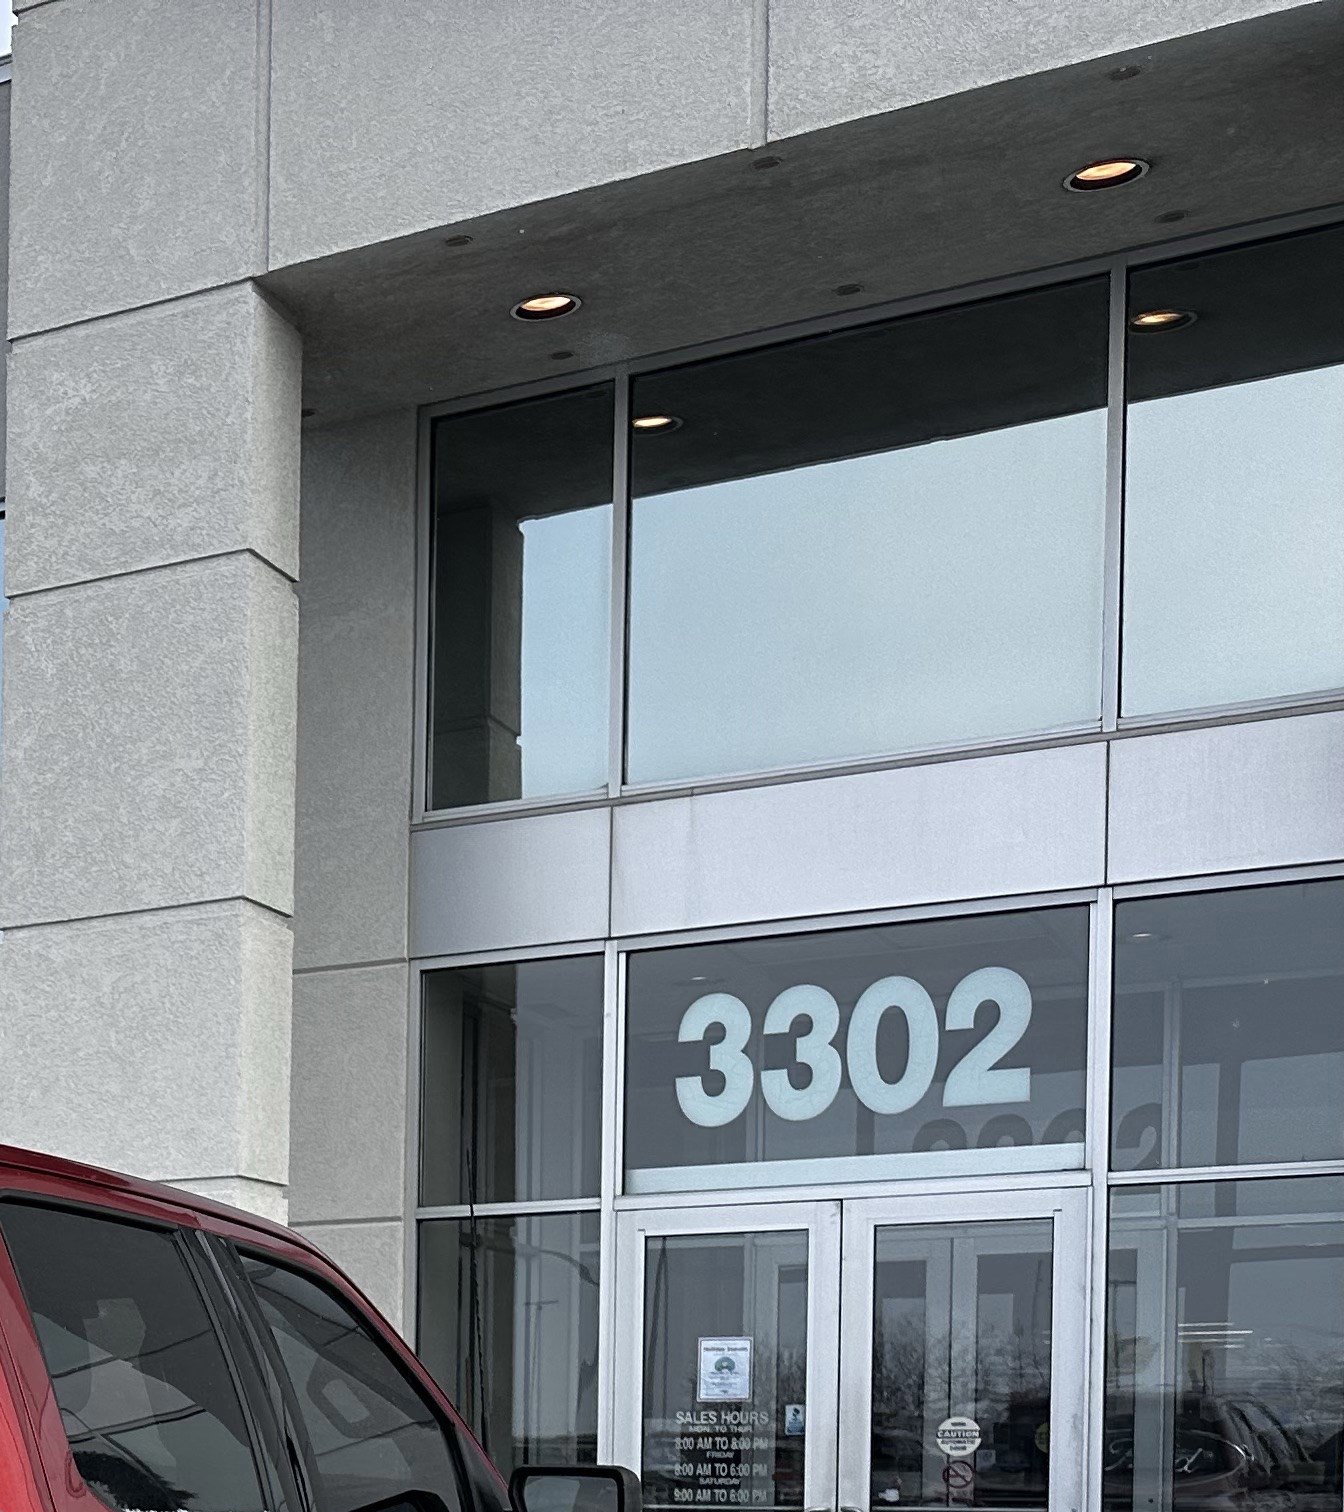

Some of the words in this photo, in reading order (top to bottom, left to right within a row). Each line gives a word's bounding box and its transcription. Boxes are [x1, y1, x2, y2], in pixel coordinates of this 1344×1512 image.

[675, 967, 1033, 1128] 3302
[676, 1411, 718, 1424] SALES
[721, 1411, 770, 1425] HOURS
[696, 1437, 713, 1450] AM
[714, 1437, 729, 1450] TO
[752, 1437, 769, 1450] PM
[695, 1463, 712, 1477] AM
[714, 1463, 728, 1477] TO
[729, 1463, 751, 1477] 6:00
[752, 1463, 768, 1477] PM
[695, 1488, 712, 1502] AM
[713, 1488, 728, 1502] TO
[752, 1488, 767, 1502] PM
